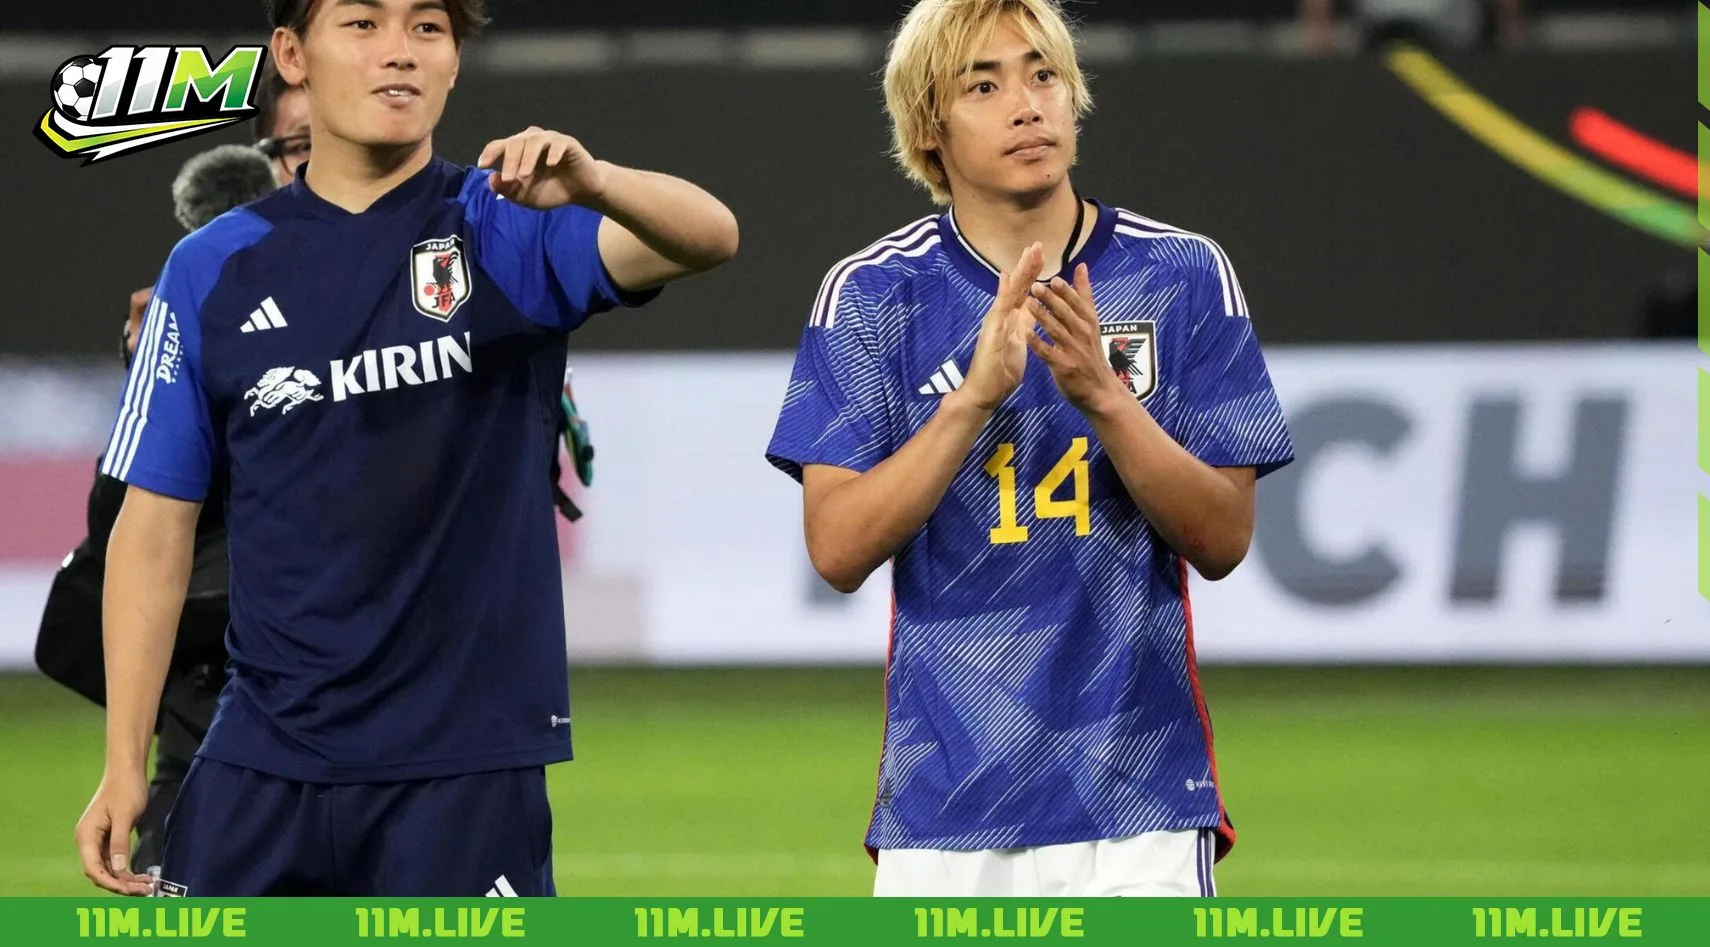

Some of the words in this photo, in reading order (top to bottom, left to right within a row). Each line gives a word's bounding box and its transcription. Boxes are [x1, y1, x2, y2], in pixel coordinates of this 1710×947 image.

[425, 238, 455, 251] JAPAN
[1101, 324, 1138, 334] JAPAN
[330, 331, 473, 402] KIRIN
[984, 437, 1091, 544] 14
[1254, 392, 1632, 608] CH
